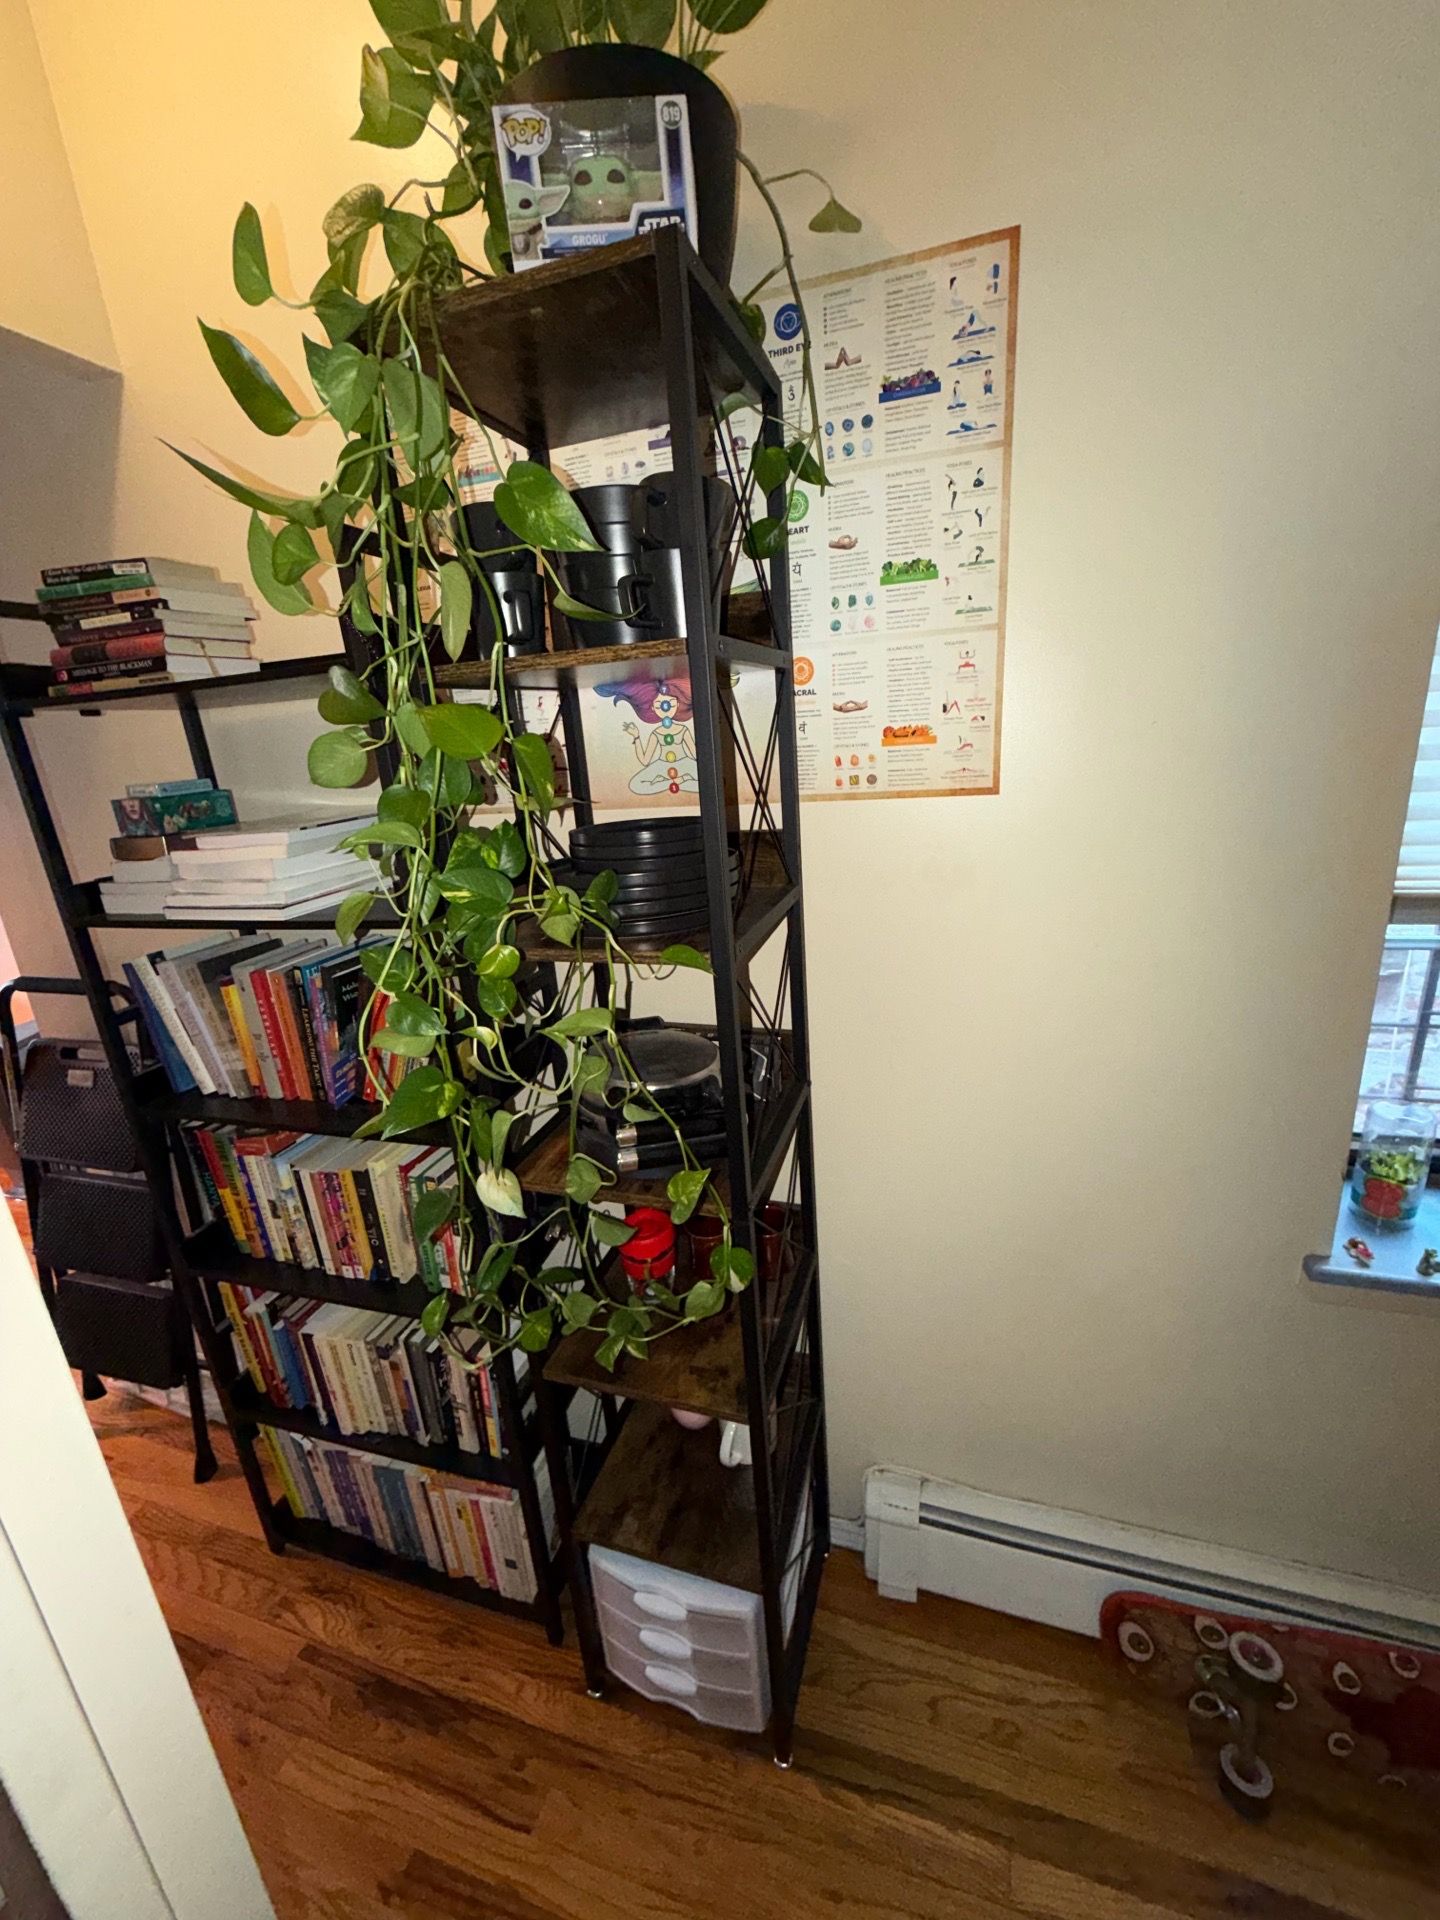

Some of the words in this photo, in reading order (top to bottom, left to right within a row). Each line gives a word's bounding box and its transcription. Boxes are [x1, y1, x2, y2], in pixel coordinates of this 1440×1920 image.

[661, 107, 682, 122] 819
[501, 117, 547, 148] POP!
[572, 233, 606, 245] GROGU
[768, 346, 794, 358] THIRD
[787, 525, 809, 535] EART
[793, 689, 817, 697] ACRAL
[301, 1007, 315, 1046] LEARNING
